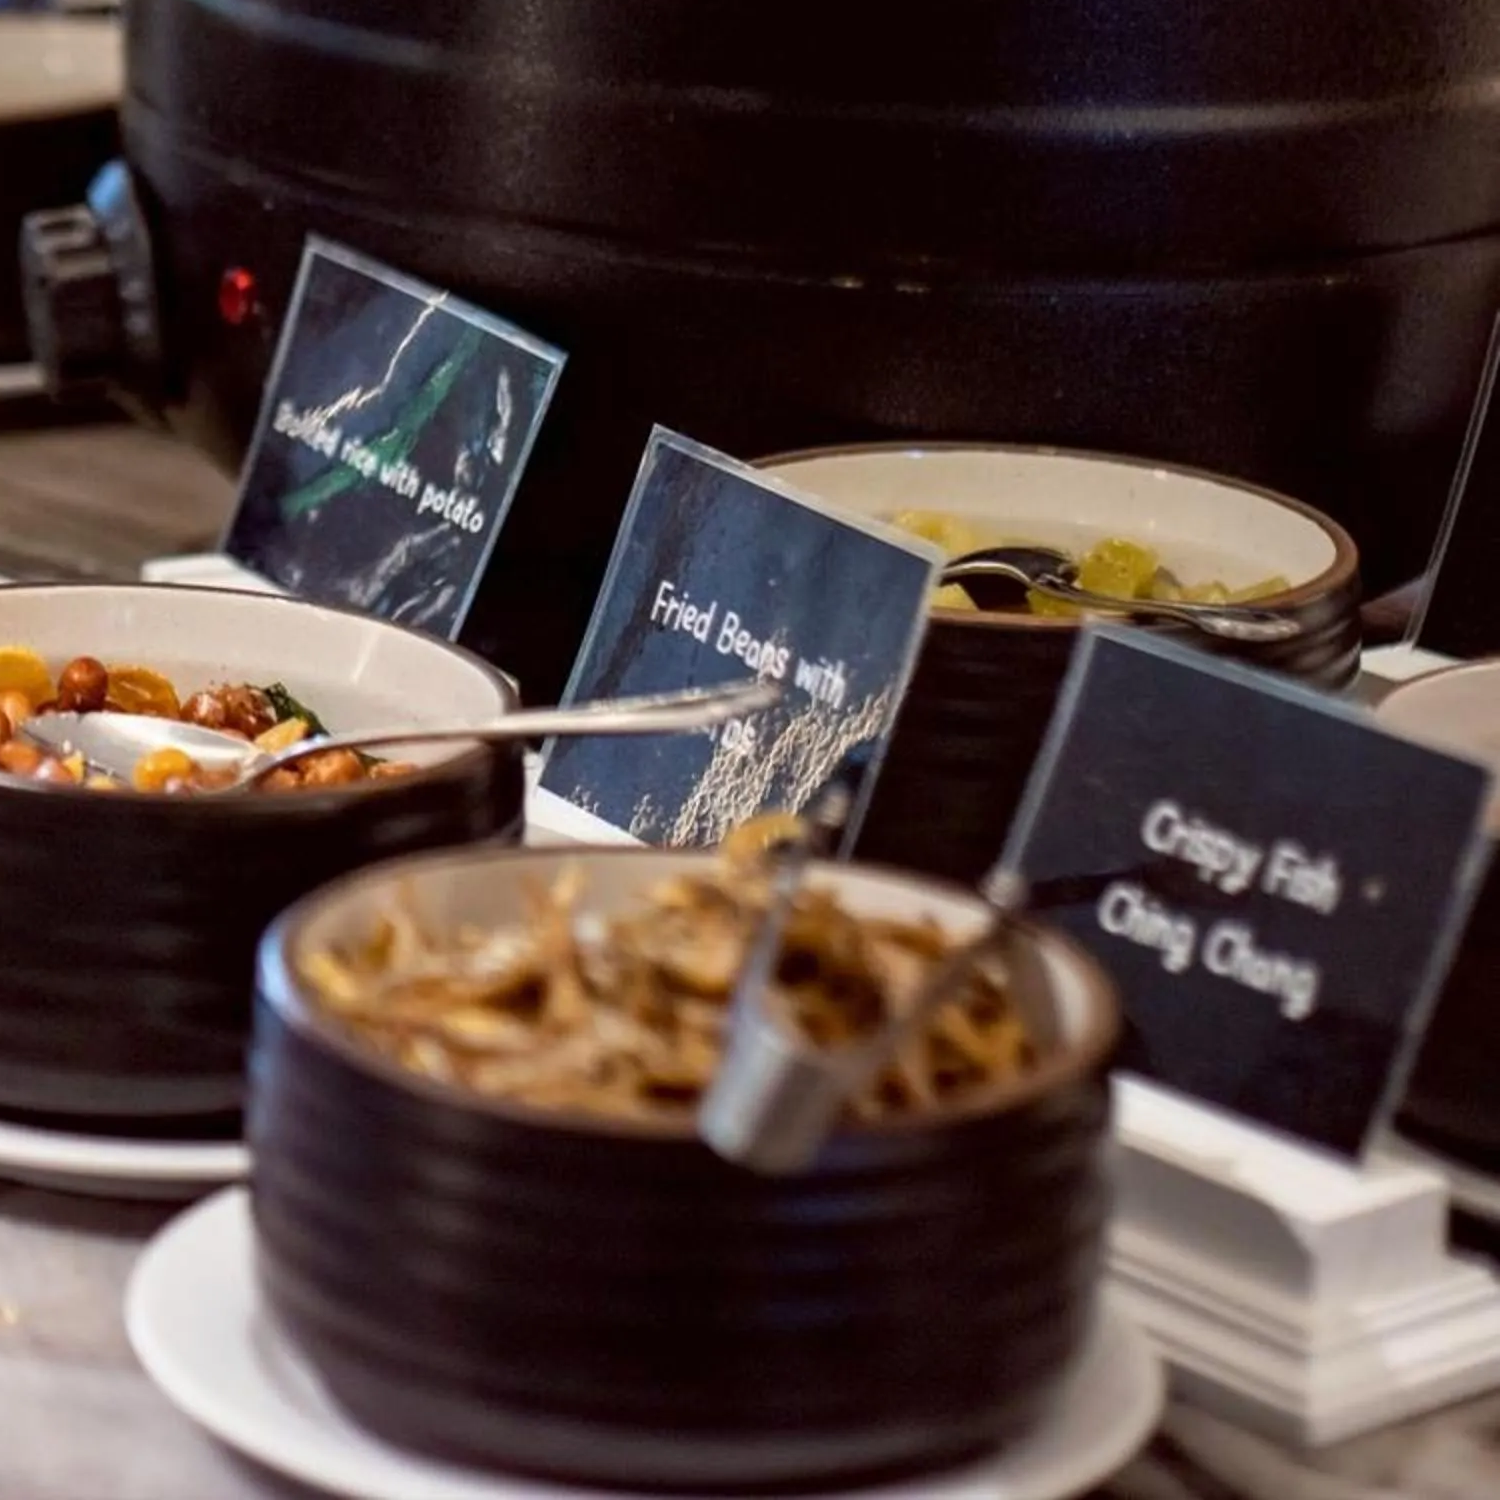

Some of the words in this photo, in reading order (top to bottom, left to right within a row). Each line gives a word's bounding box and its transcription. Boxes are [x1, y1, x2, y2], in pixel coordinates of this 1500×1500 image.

[340, 437, 379, 477] rice
[379, 459, 420, 499] with
[419, 480, 484, 534] potato
[650, 580, 717, 642] Fried
[716, 611, 790, 679] Beans
[795, 653, 847, 704] with
[1141, 802, 1261, 894] Crispy
[1263, 838, 1340, 913] Fish
[1098, 881, 1195, 974] Ching
[1204, 920, 1320, 1021] Chang
